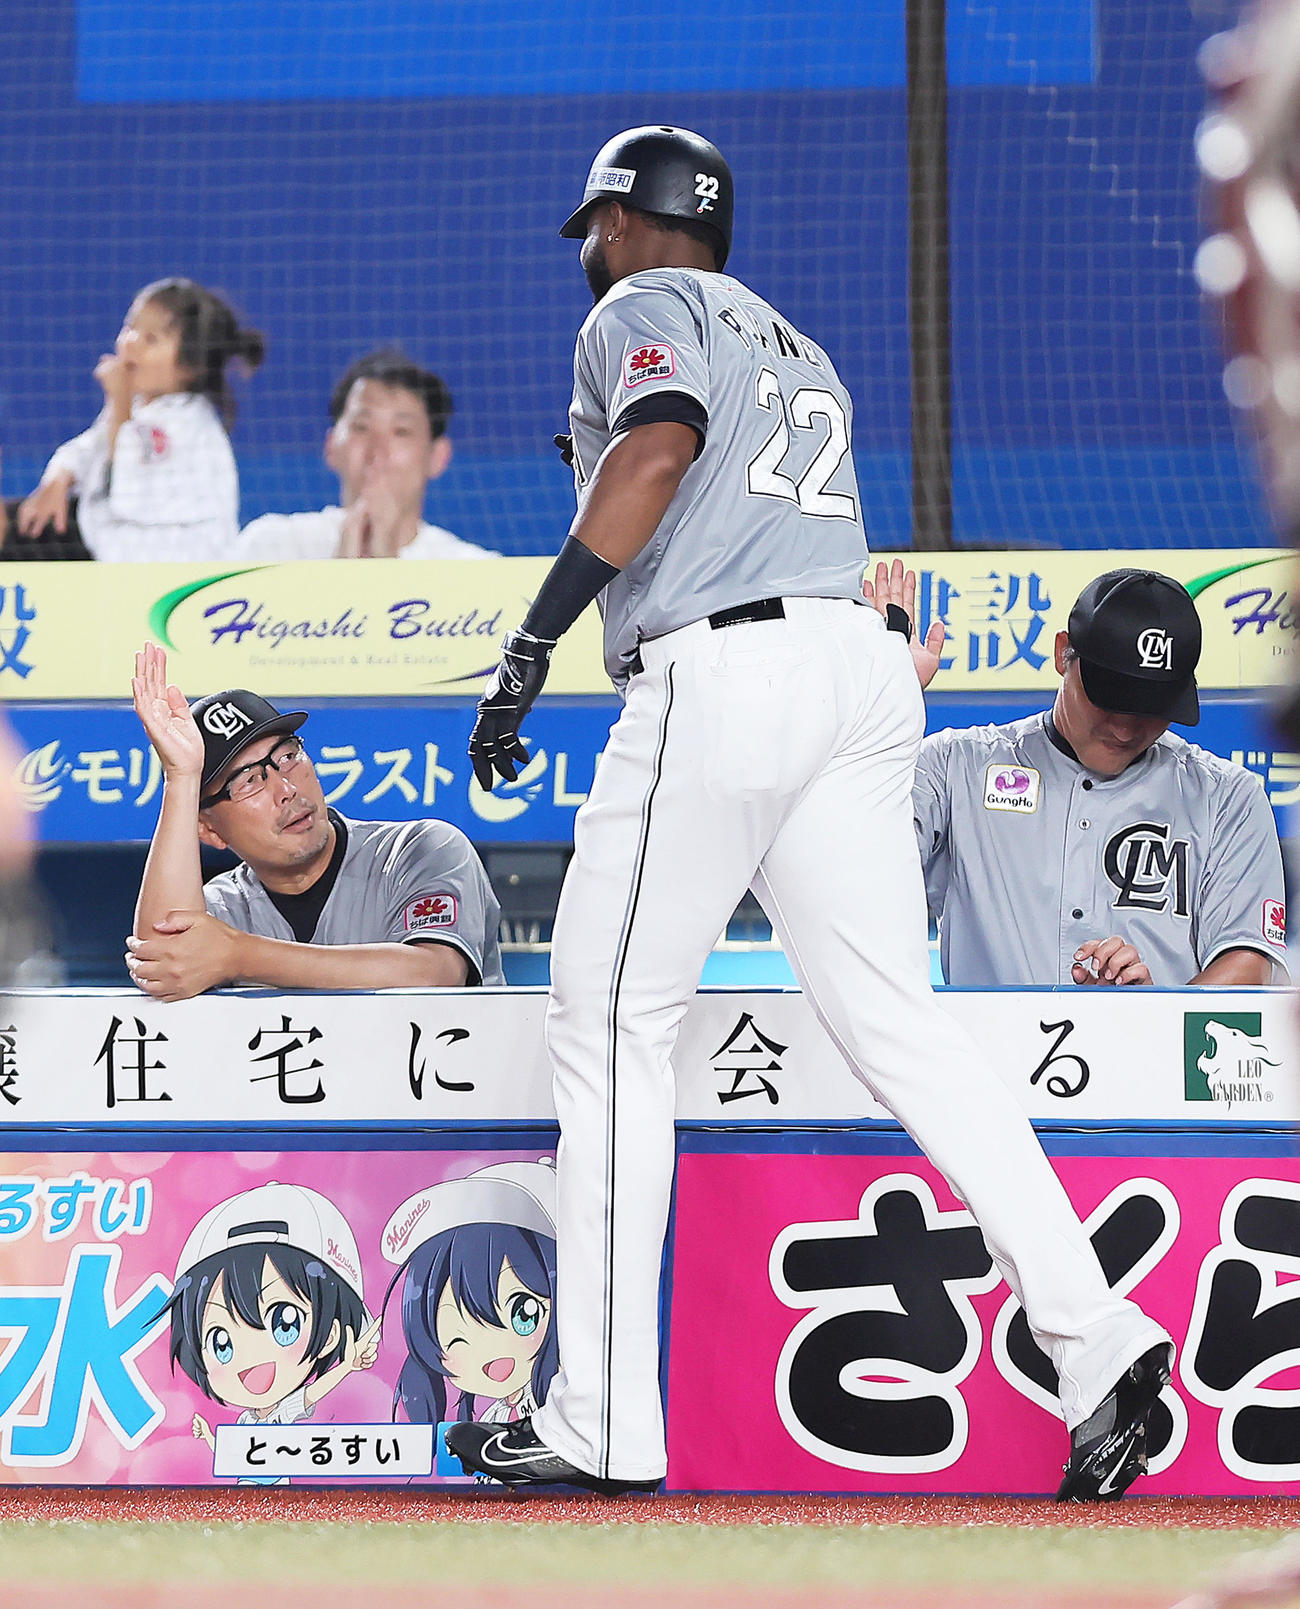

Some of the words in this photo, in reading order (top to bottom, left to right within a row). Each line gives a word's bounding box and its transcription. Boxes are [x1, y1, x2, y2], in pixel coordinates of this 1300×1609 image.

[694, 172, 719, 201] 22
[745, 363, 858, 527] 22
[203, 598, 368, 650] Higashi
[388, 598, 503, 641] Build
[987, 793, 1033, 809] GungHo
[1238, 1060, 1262, 1078] LEO
[386, 1198, 431, 1254] Marines
